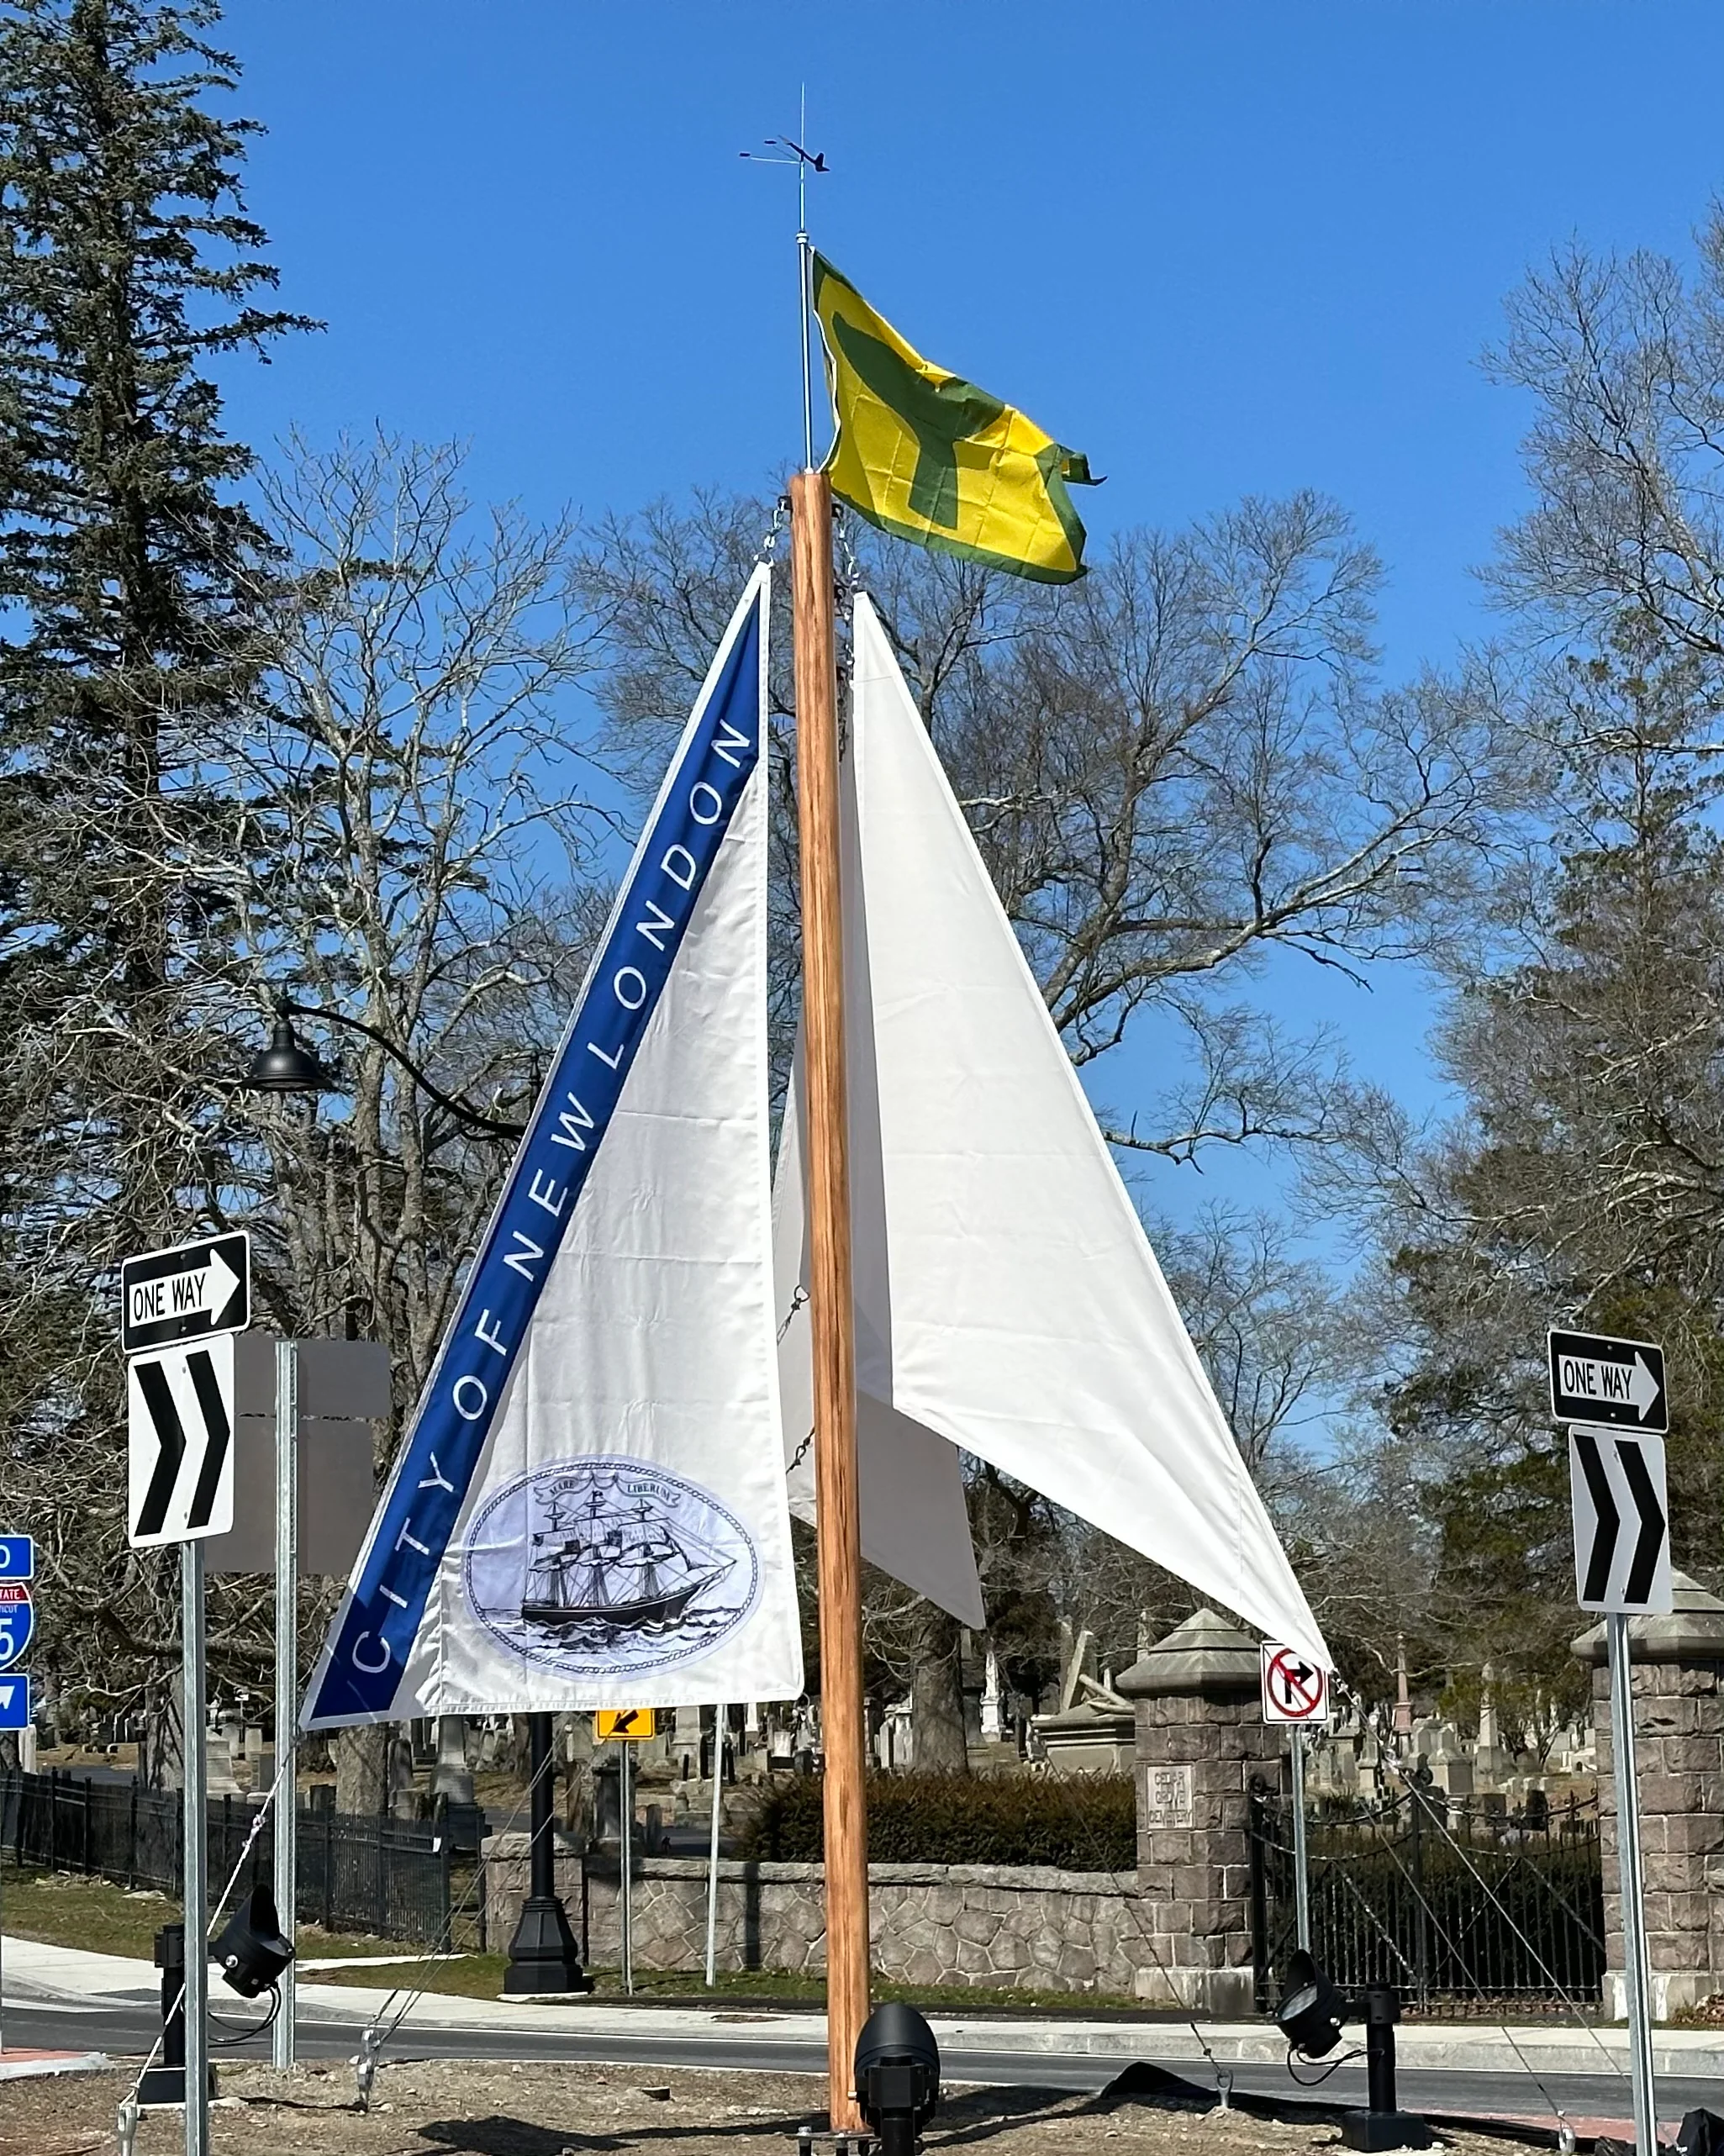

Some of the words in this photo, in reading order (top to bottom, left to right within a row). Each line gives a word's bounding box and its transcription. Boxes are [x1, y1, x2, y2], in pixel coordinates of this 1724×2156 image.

[351, 1450, 456, 1674] CITY
[451, 1308, 509, 1421] OF
[503, 1090, 596, 1283] NEW
[588, 718, 752, 1071] LONDON
[133, 1282, 166, 1322] ONE
[171, 1272, 207, 1313] WAY
[1563, 1359, 1597, 1395] ONE
[1601, 1364, 1633, 1400] WAY
[549, 1479, 575, 1495] MARE
[627, 1483, 671, 1501] LIBERUM
